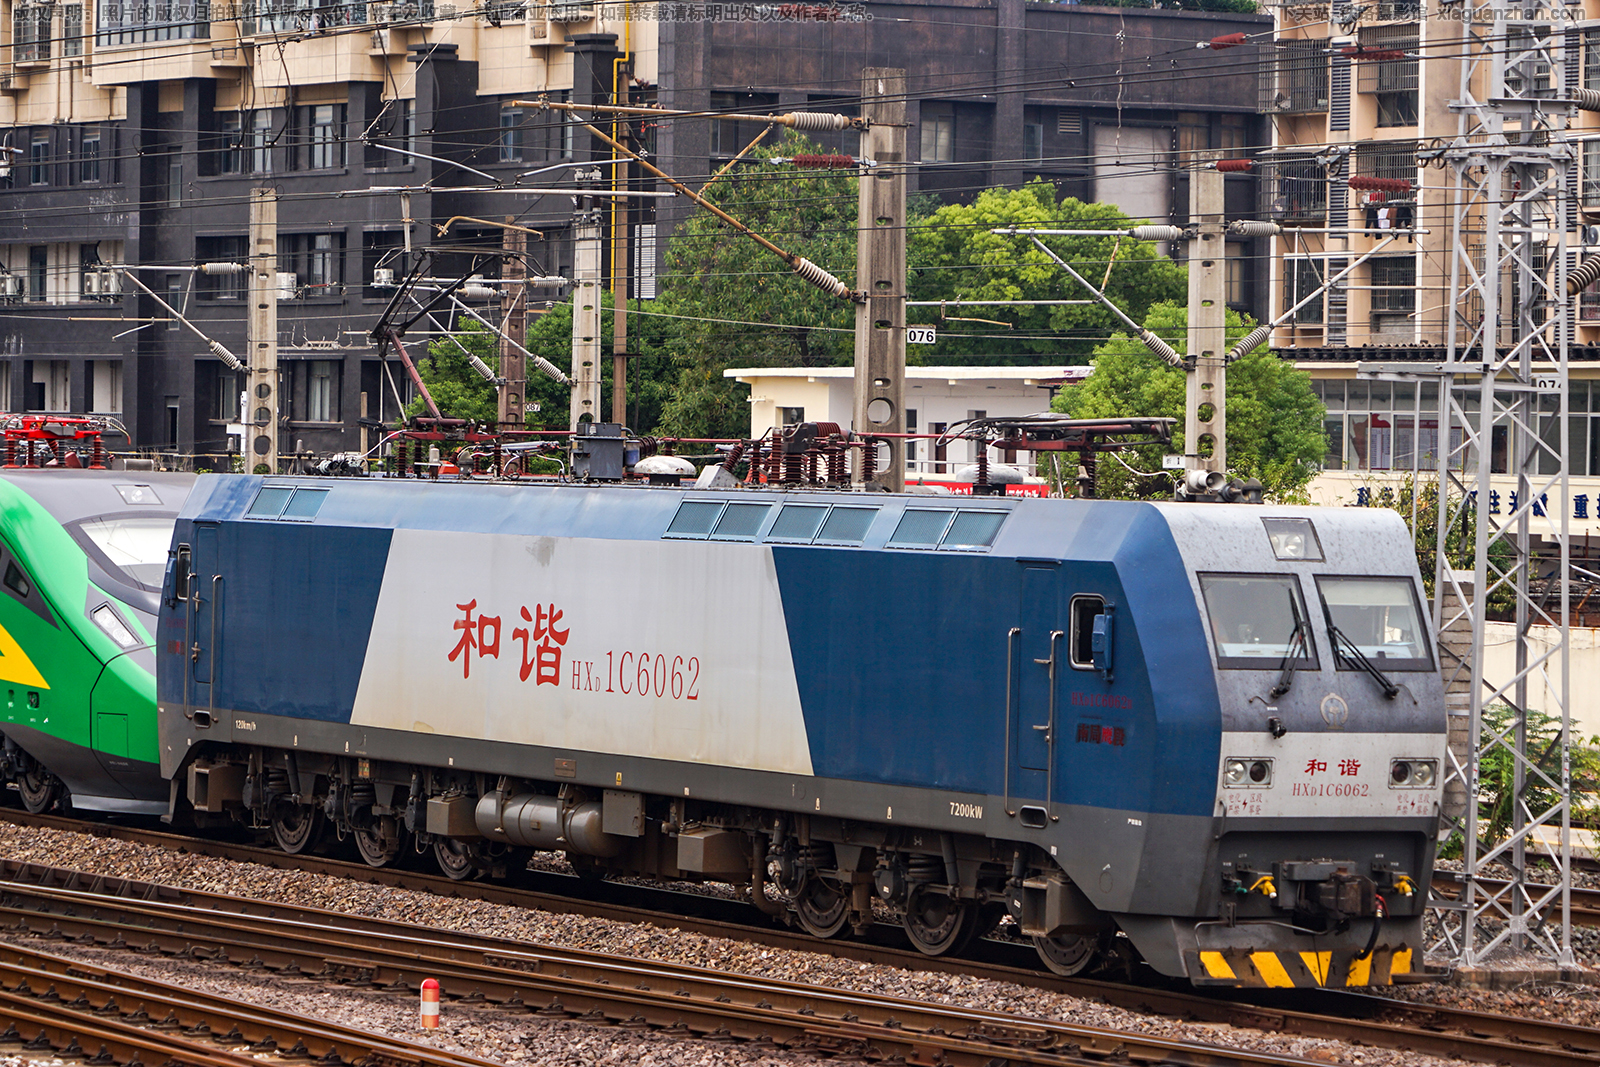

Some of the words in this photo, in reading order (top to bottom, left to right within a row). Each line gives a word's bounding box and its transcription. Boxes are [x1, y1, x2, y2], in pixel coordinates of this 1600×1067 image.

[908, 330, 934, 342] 076
[447, 598, 570, 687] 和谐
[1304, 759, 1361, 777] 和谐
[949, 801, 983, 819] 7200kW
